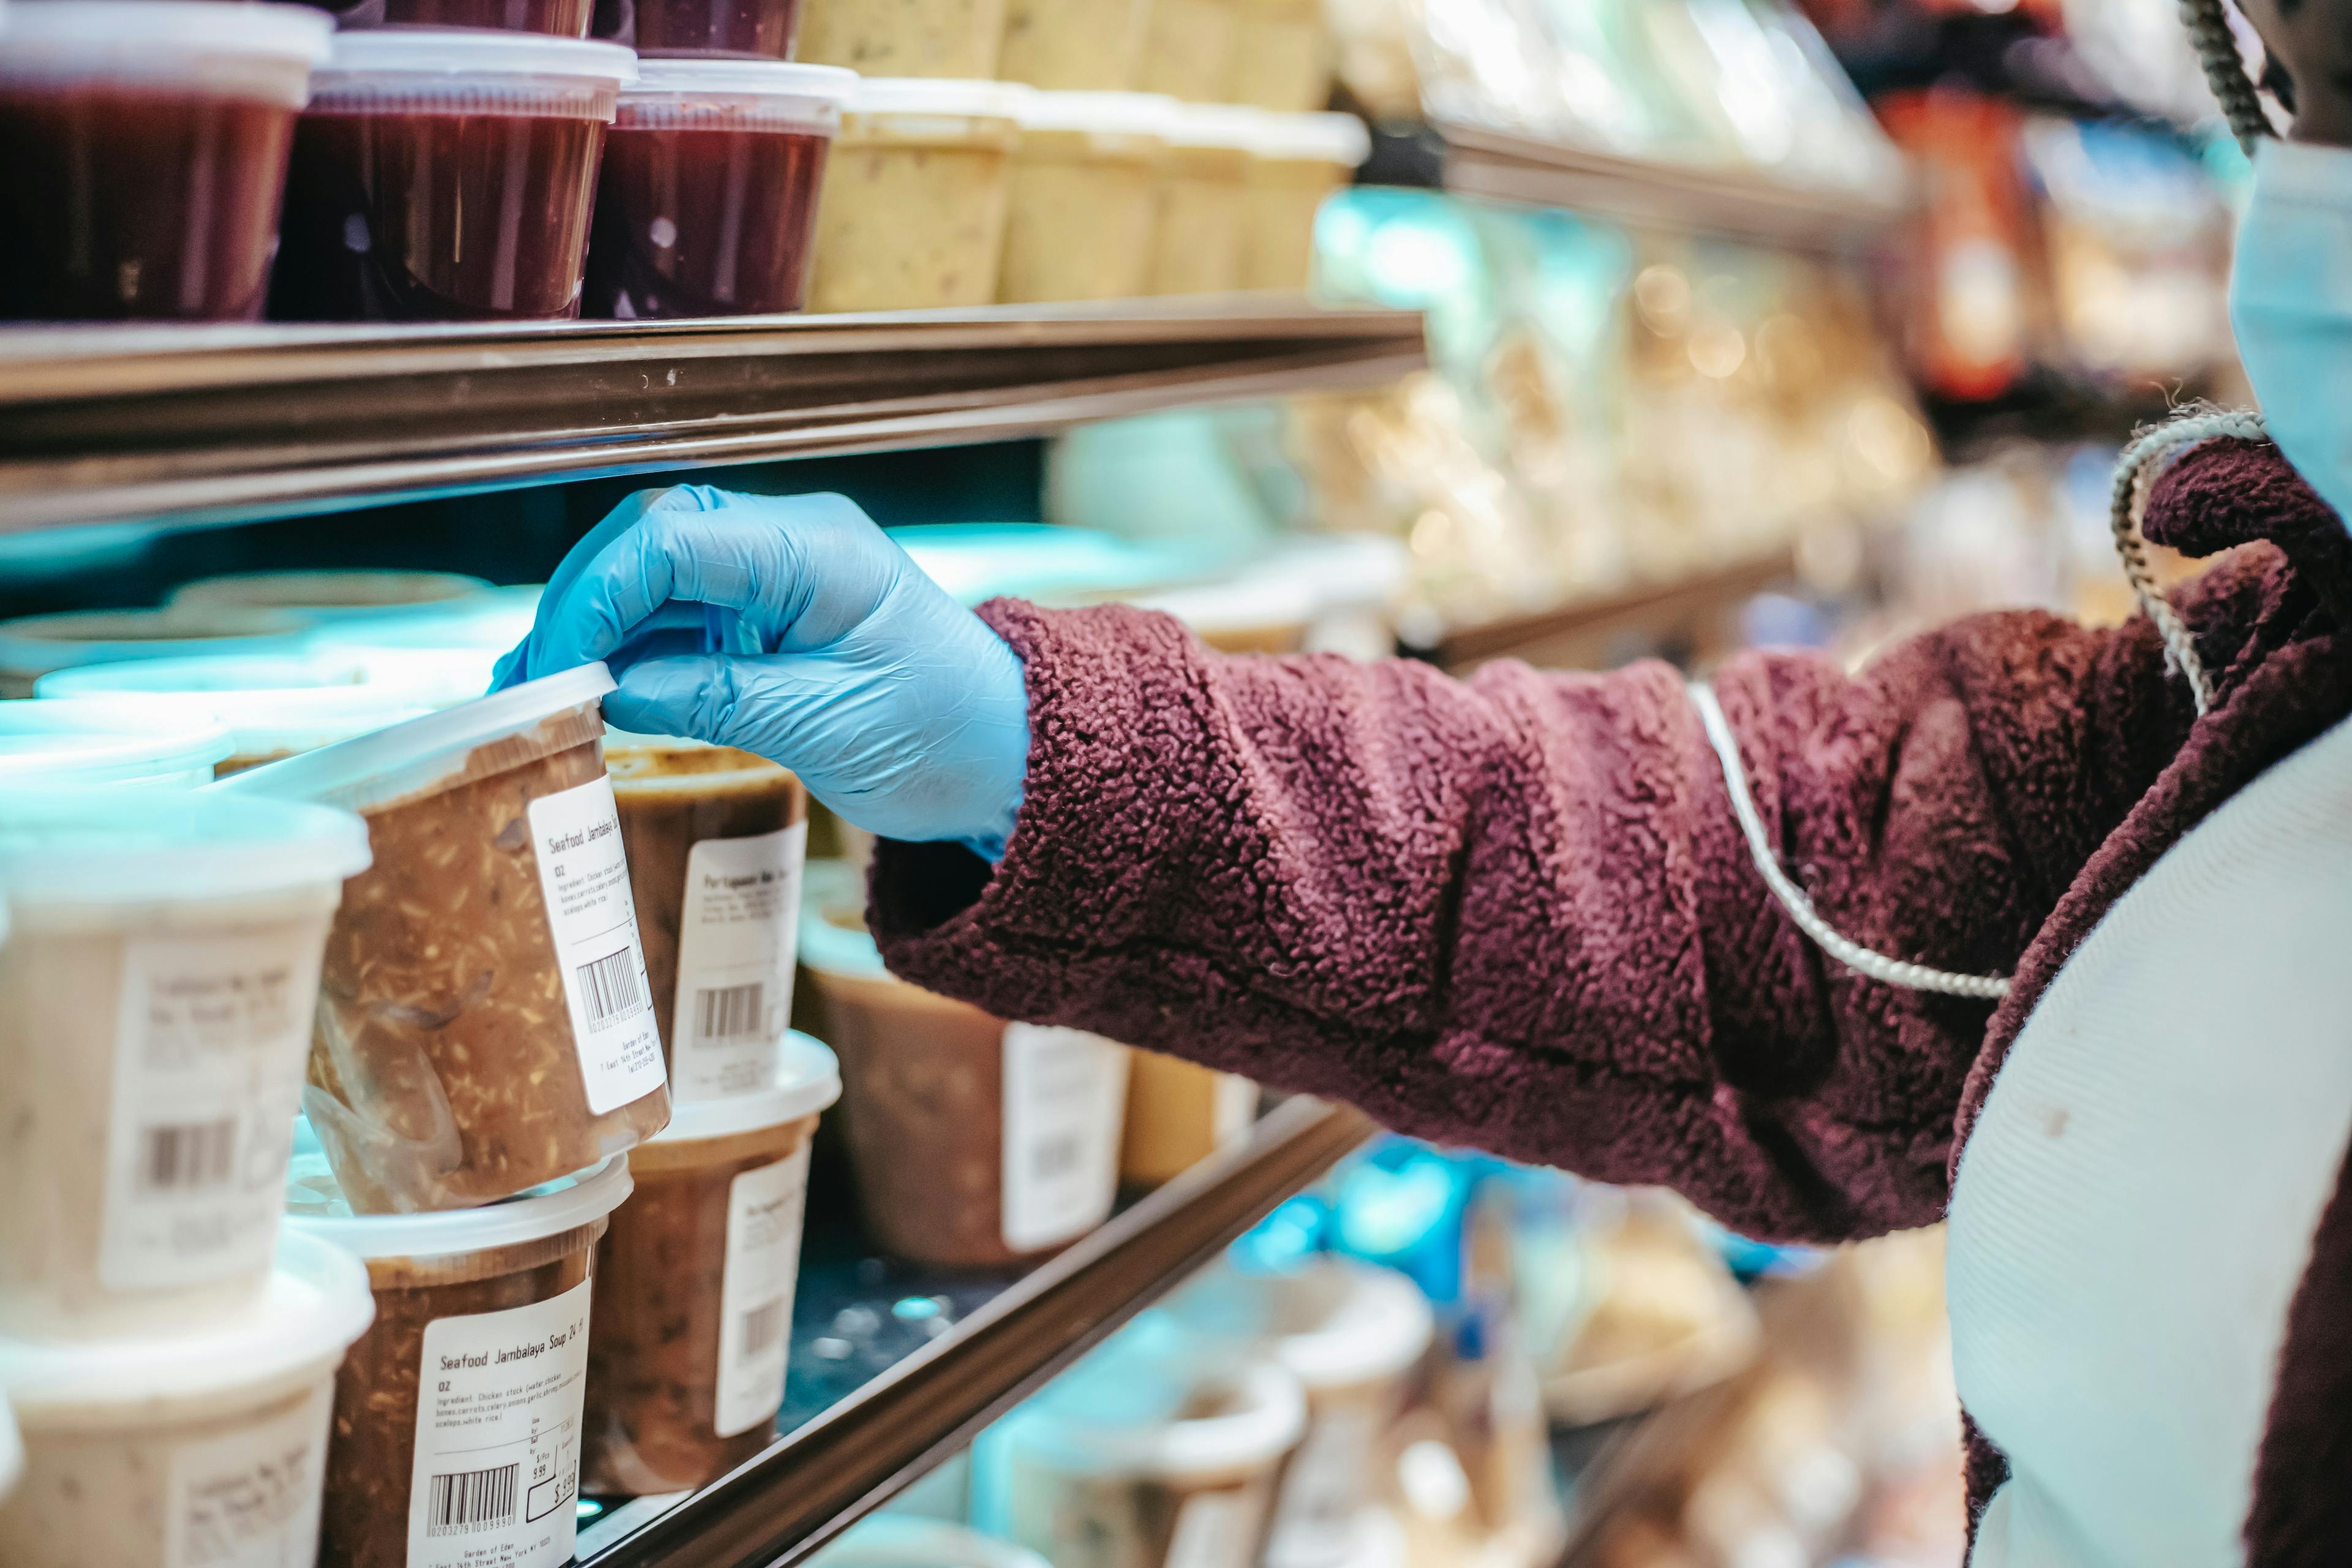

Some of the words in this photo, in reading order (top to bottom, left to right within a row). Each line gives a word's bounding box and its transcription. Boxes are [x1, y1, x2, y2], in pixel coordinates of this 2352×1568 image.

[549, 829, 584, 854] Seafood
[440, 1351, 488, 1371] Seafood
[495, 1342, 545, 1365] Jambalaya
[549, 1333, 567, 1349] Soup
[569, 1322, 576, 1340] 24
[478, 1391, 503, 1402] Chicken
[506, 1386, 523, 1397] stock
[533, 1464, 546, 1480] 9.99
[431, 1525, 469, 1537] 0203279
[477, 1516, 512, 1532] 009990
[464, 1548, 487, 1559] Garden
[491, 1545, 497, 1554] of
[500, 1543, 514, 1552] Eden
[475, 1556, 496, 1568] Street
[515, 1548, 527, 1559] York
[530, 1544, 537, 1552] NY
